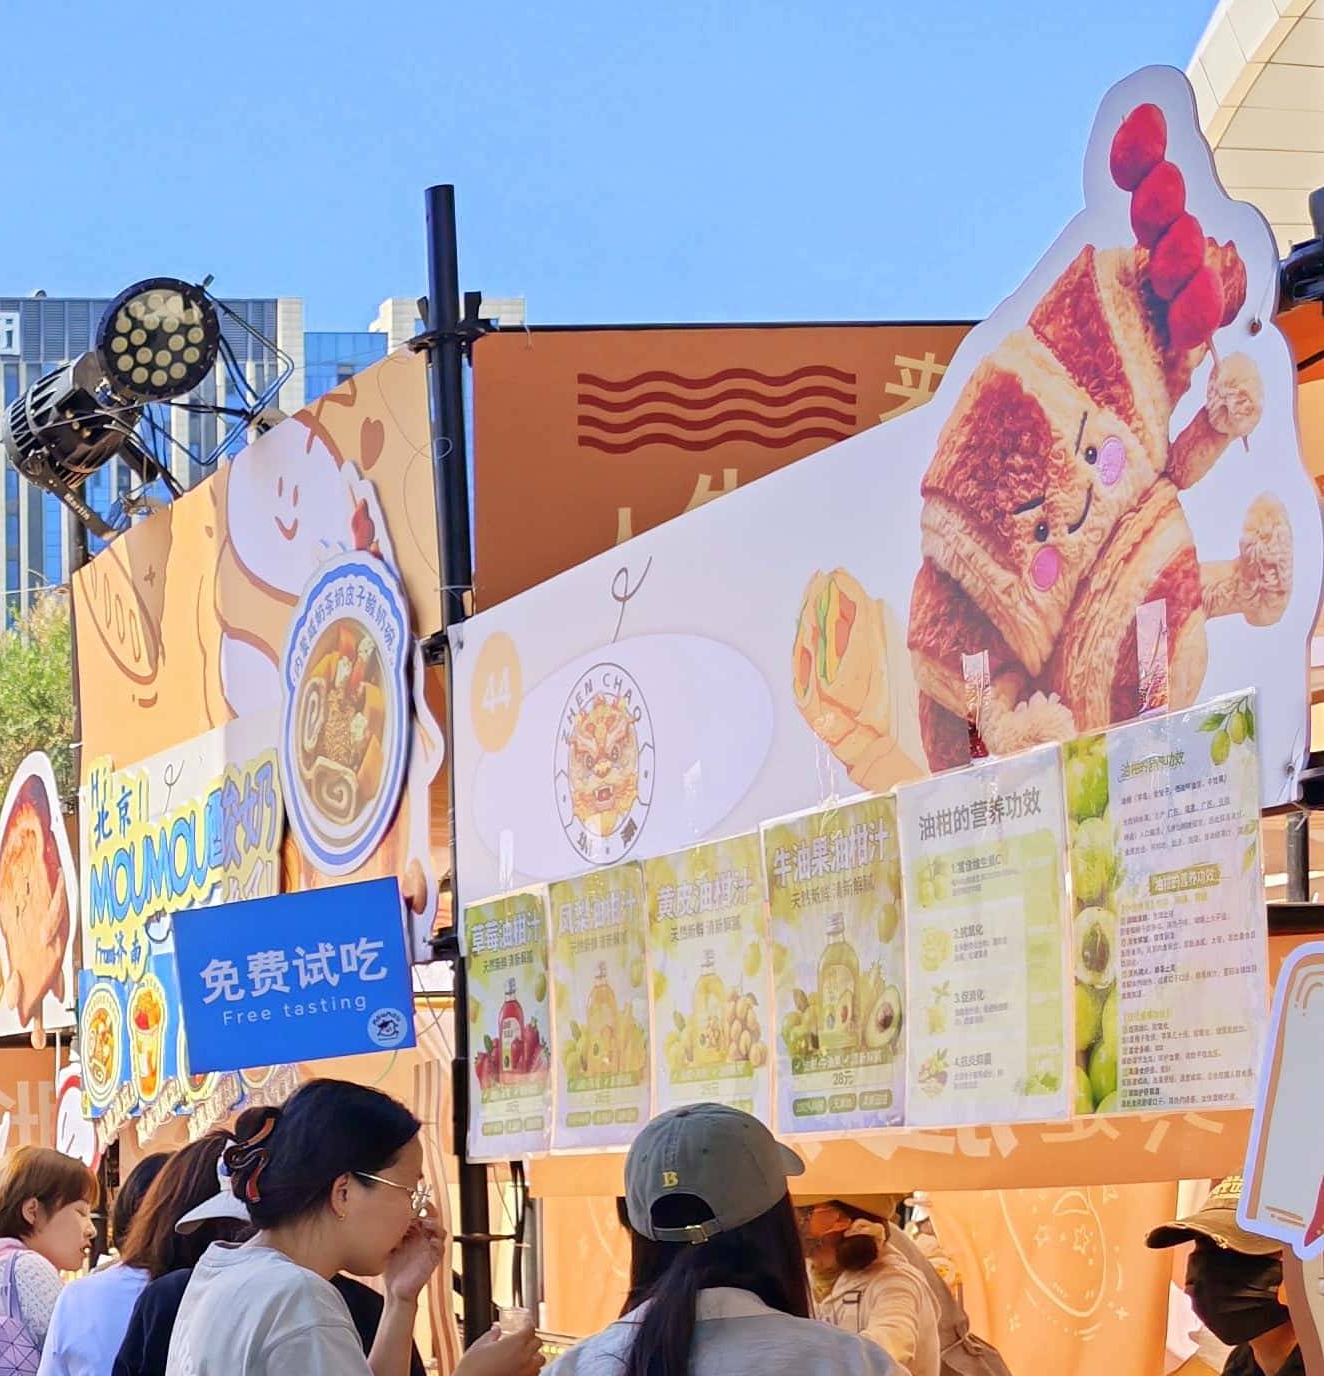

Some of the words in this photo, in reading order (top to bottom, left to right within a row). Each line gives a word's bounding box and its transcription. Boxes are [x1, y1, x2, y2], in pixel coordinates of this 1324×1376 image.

[919, 786, 1042, 841] 油柑的营养功效
[773, 818, 889, 887] 牛油果油柑汁
[657, 867, 753, 922] 黄皮油柑汁
[199, 936, 388, 1005] 免费试吃
[223, 1010, 272, 1026] Free
[283, 995, 368, 1018] tasting
[662, 1170, 680, 1188] B
